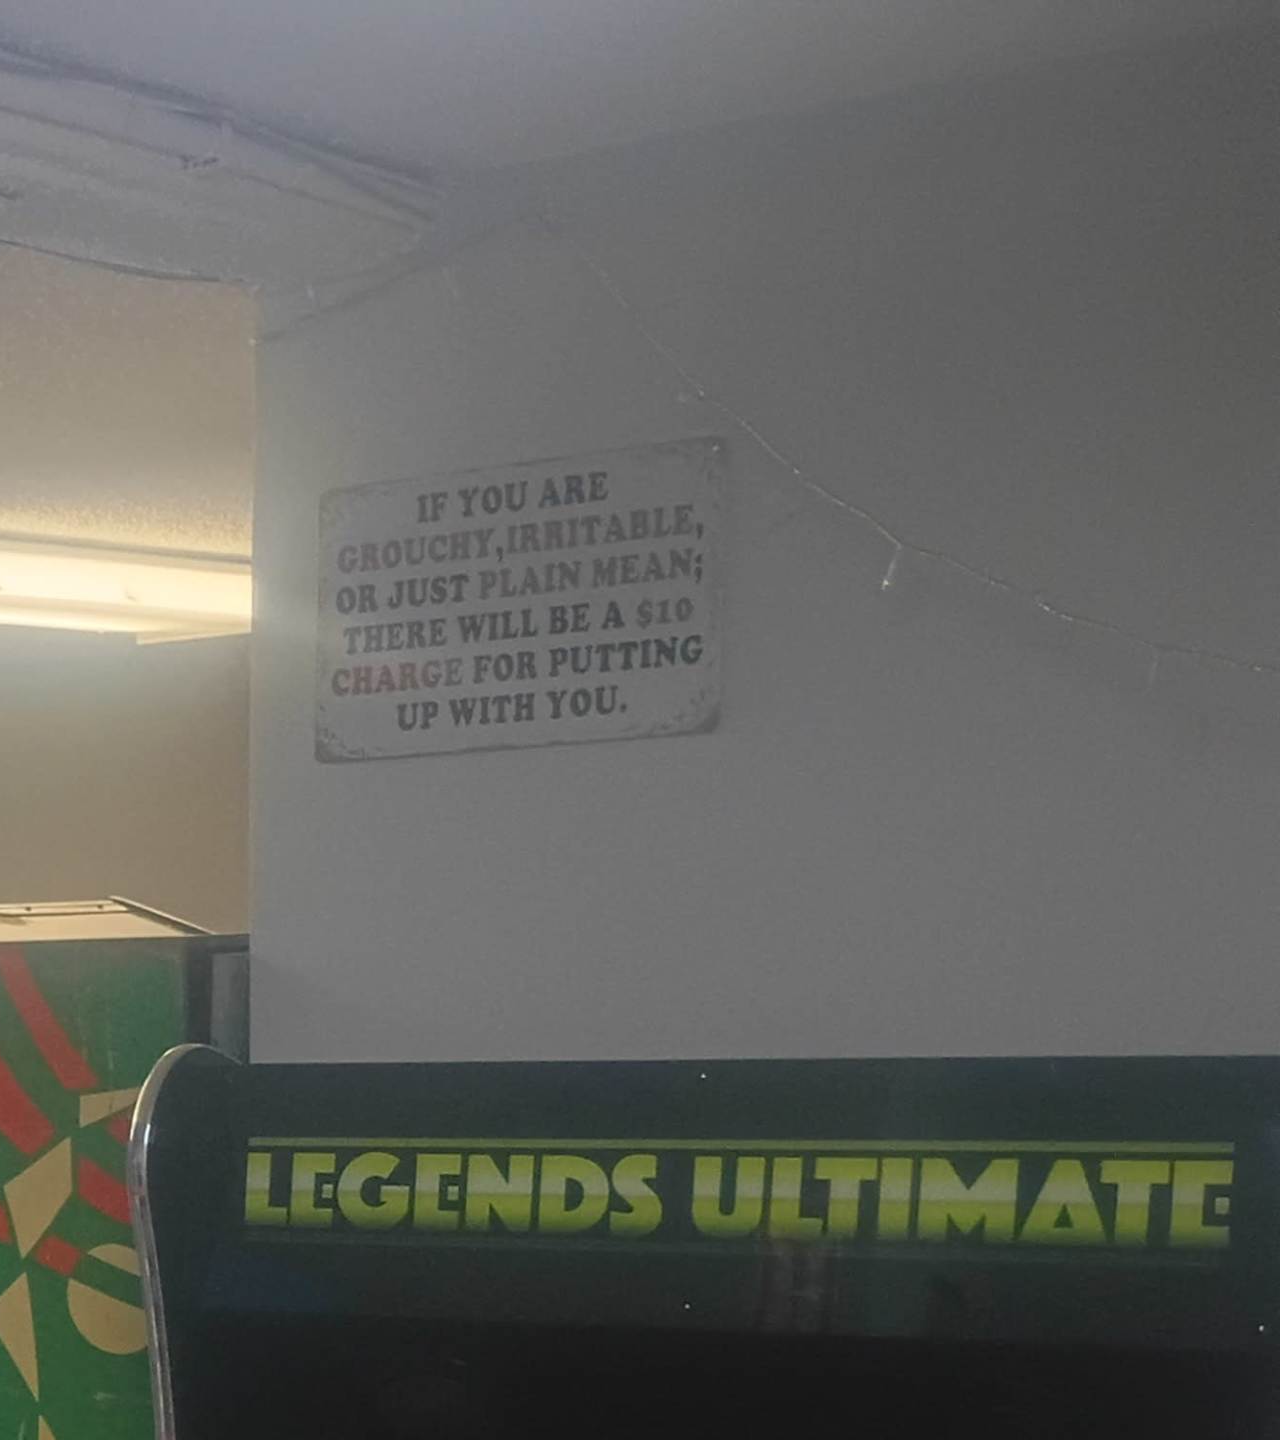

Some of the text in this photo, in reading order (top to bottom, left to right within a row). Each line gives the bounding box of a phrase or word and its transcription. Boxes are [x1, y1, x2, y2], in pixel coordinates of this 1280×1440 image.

[416, 471, 609, 523] IF YOU ARE
[335, 583, 378, 615] OR
[388, 573, 470, 610] JUST
[477, 561, 582, 600] PLAIN
[343, 597, 695, 656] THERE WILL BE A $10
[331, 634, 704, 697] CHARGE FOR PUTTING
[396, 685, 628, 731] UP WITH YOU.
[243, 1151, 1235, 1248] LEGENDS ULTIMATE
